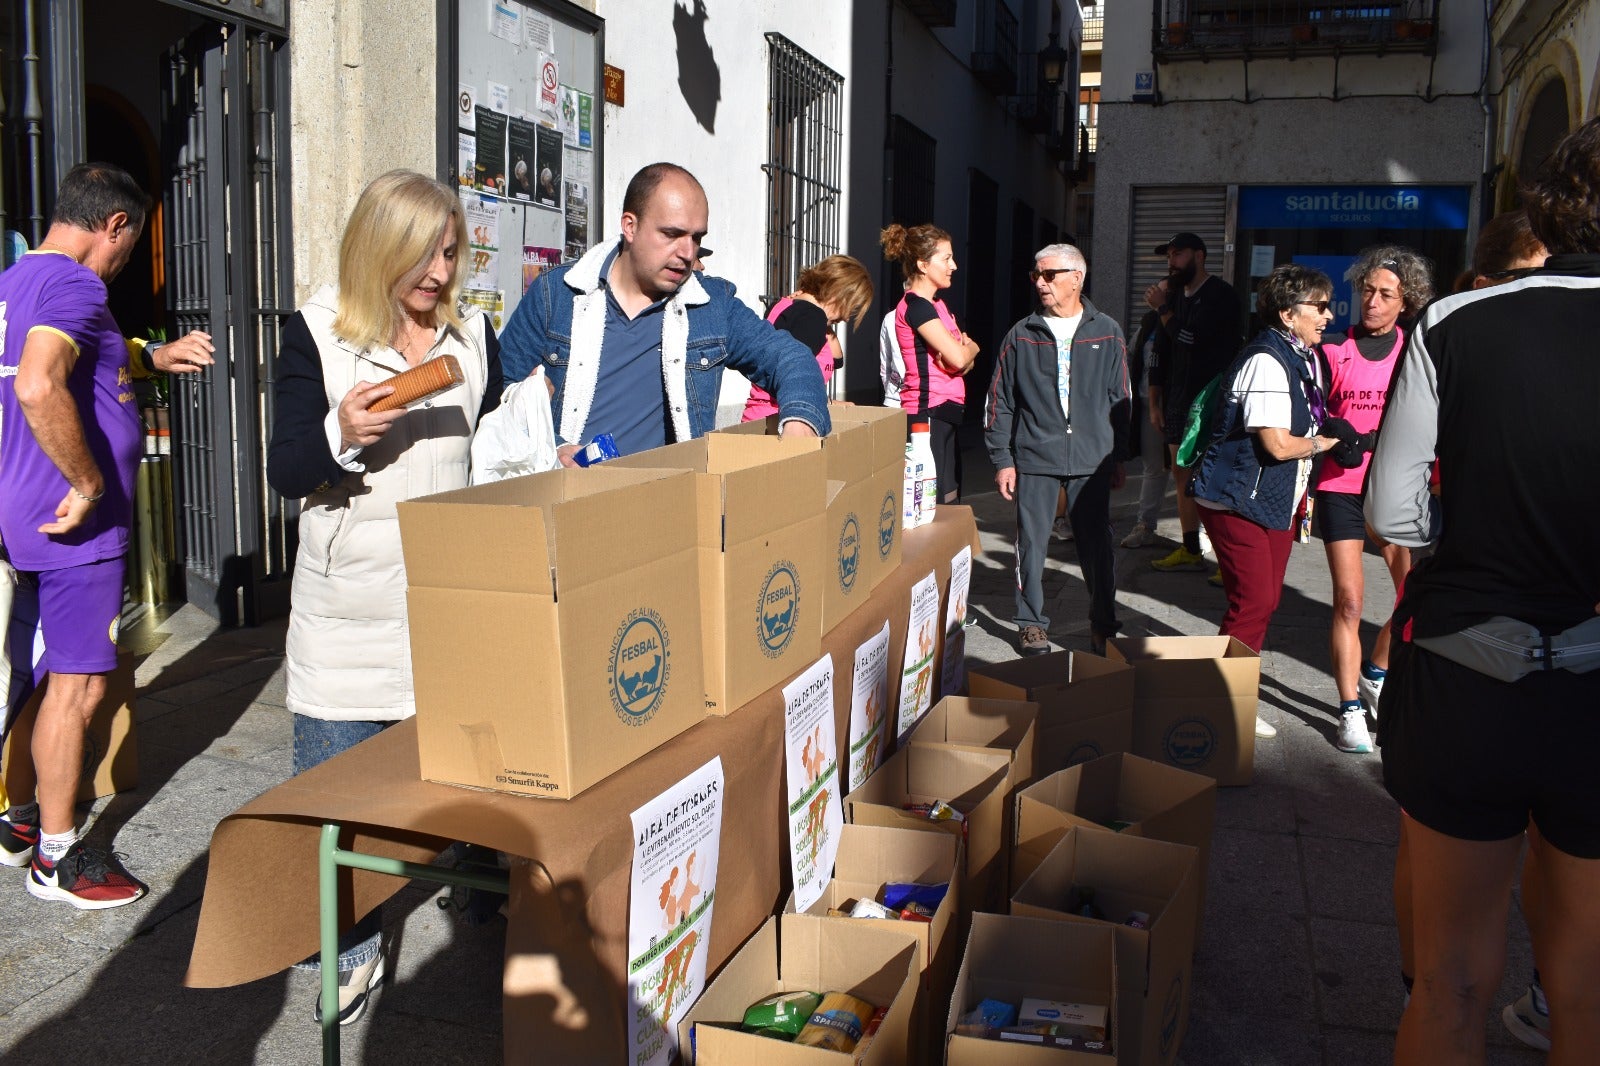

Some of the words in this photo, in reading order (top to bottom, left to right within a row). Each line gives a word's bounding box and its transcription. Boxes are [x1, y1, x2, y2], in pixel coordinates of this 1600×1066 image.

[1286, 190, 1419, 211] santalucía
[1330, 213, 1372, 223] SEGUROS
[1360, 391, 1372, 400] DE
[766, 585, 793, 605] FESBAL
[607, 620, 627, 673] BANCOS
[627, 609, 638, 623] DE
[638, 607, 671, 647] ALIMENTOS
[621, 636, 658, 664] FESBAL
[609, 688, 632, 726] BANCOS
[632, 716, 643, 728] DE
[643, 663, 671, 725] ALIMENTOS
[507, 776, 535, 787] Smurfit
[536, 780, 559, 791] Kappa
[647, 818, 691, 856] ENTRENAMIENTO
